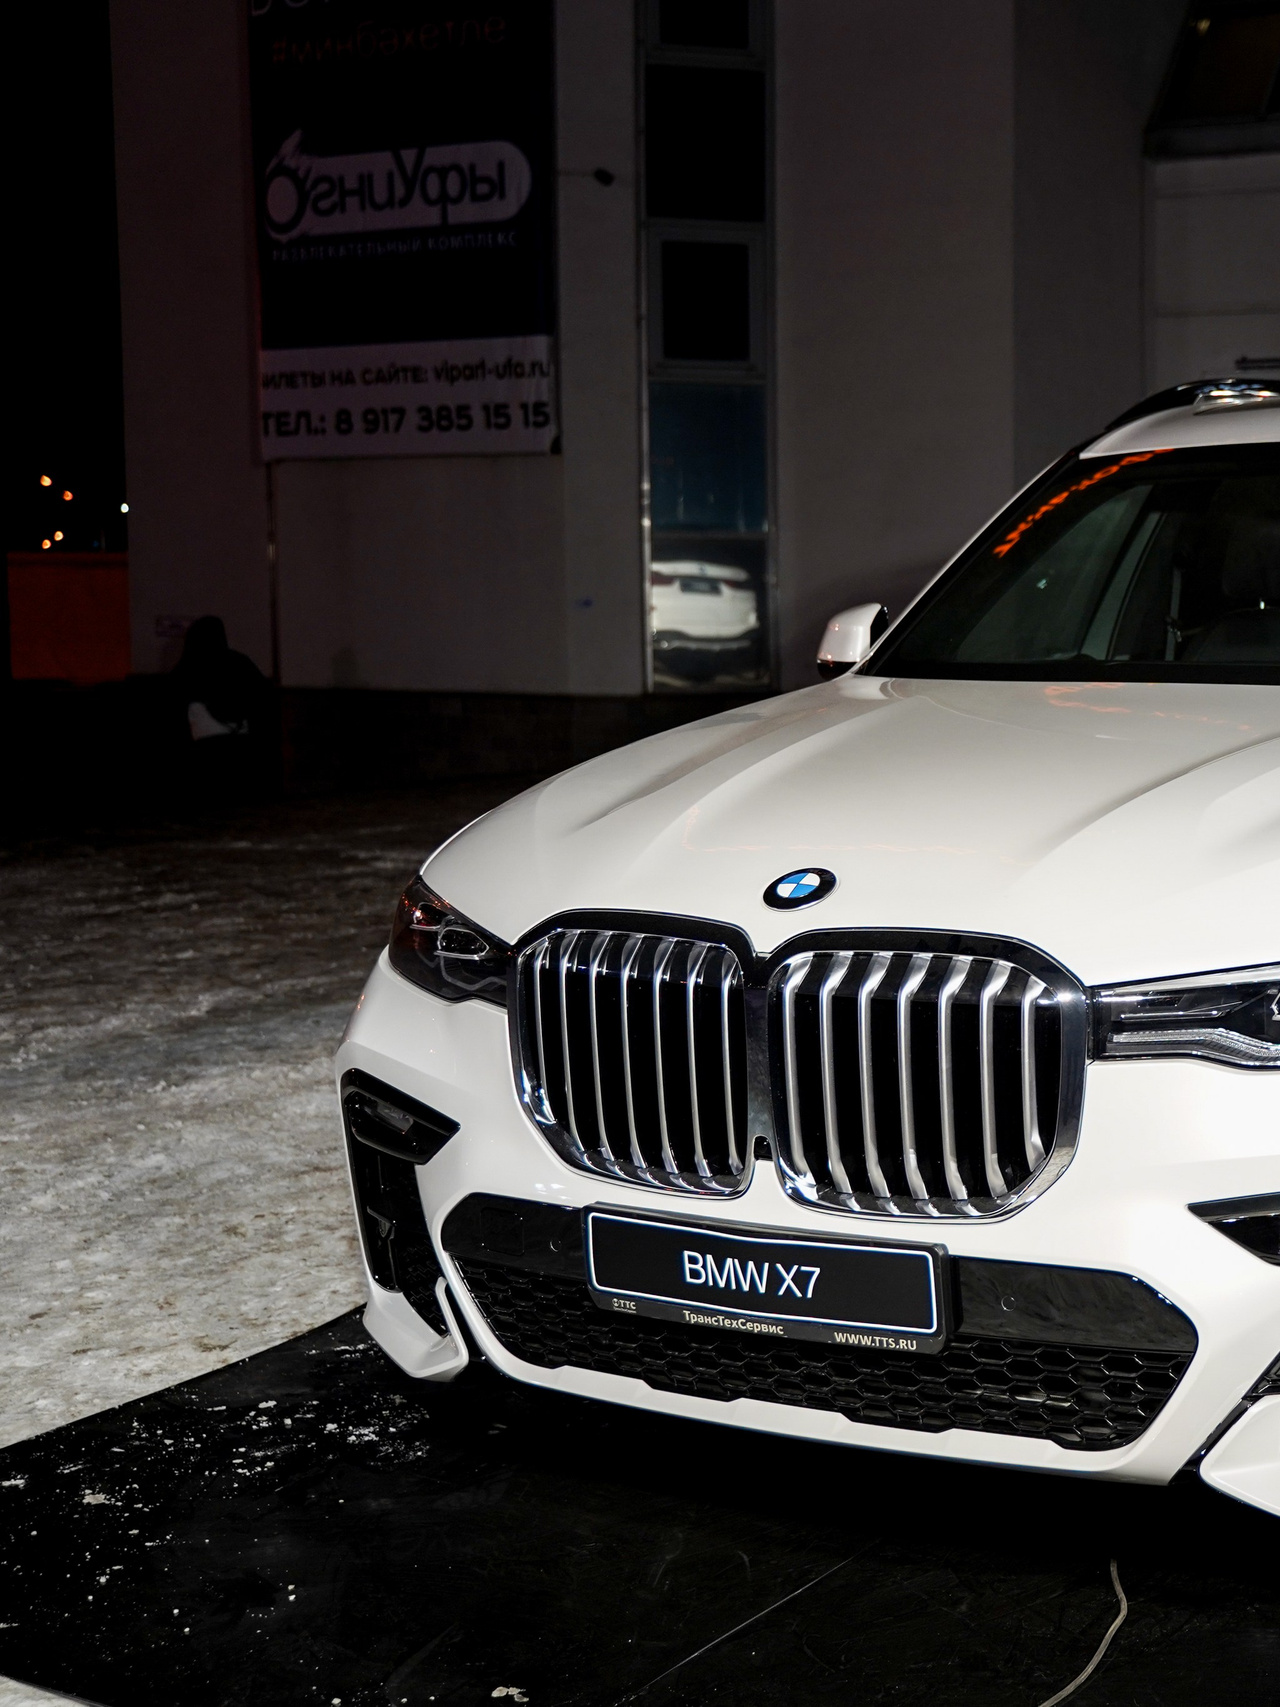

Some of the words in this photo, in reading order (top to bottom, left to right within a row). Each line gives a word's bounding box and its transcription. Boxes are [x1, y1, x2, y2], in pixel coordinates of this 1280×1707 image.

[427, 230, 519, 253] КОМПЛЕКС
[330, 368, 356, 387] НА
[360, 362, 428, 386] САЙТЕ:
[335, 407, 353, 435] 8
[362, 407, 406, 434] 917
[416, 404, 473, 432] 385
[482, 403, 511, 430] 15
[519, 401, 550, 428] 15
[682, 1249, 769, 1294] BMW
[775, 1263, 821, 1299] X7
[683, 1310, 784, 1335] ТрансТехСервис
[834, 1331, 918, 1350] WWW.TTS.RU
